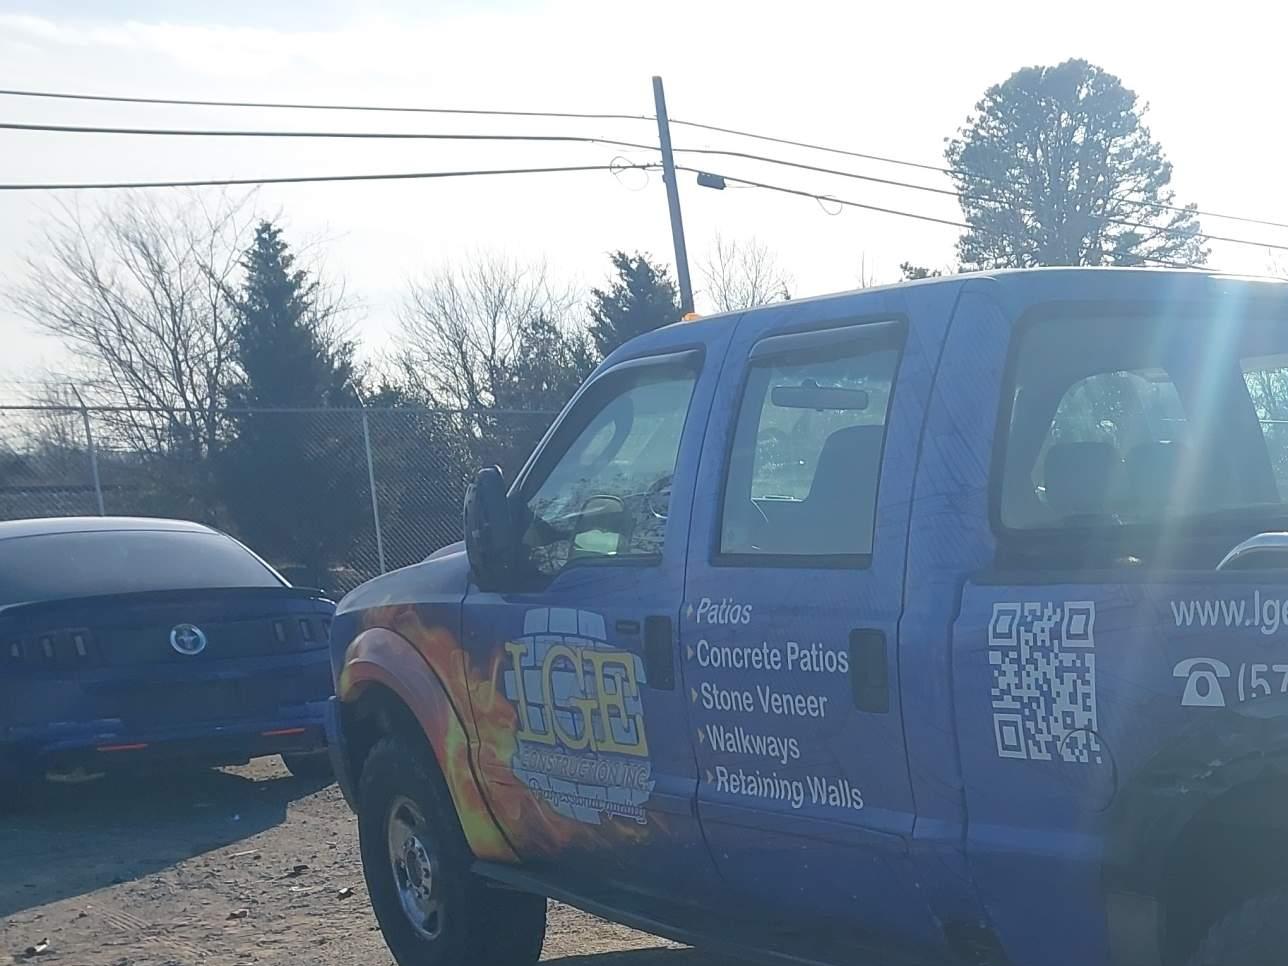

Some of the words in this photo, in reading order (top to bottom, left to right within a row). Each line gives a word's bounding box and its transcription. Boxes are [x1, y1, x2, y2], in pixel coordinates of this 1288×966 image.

[696, 597, 752, 626] Patios
[696, 640, 782, 670] Concrete
[787, 647, 850, 673] Patios
[505, 641, 649, 757] LGE
[701, 682, 754, 712] Stone
[756, 687, 828, 718] Veneer
[706, 724, 801, 765] Walkways
[521, 750, 618, 786] CONSTRUCTION
[716, 766, 804, 809] Retaining
[807, 776, 864, 810] Walls
